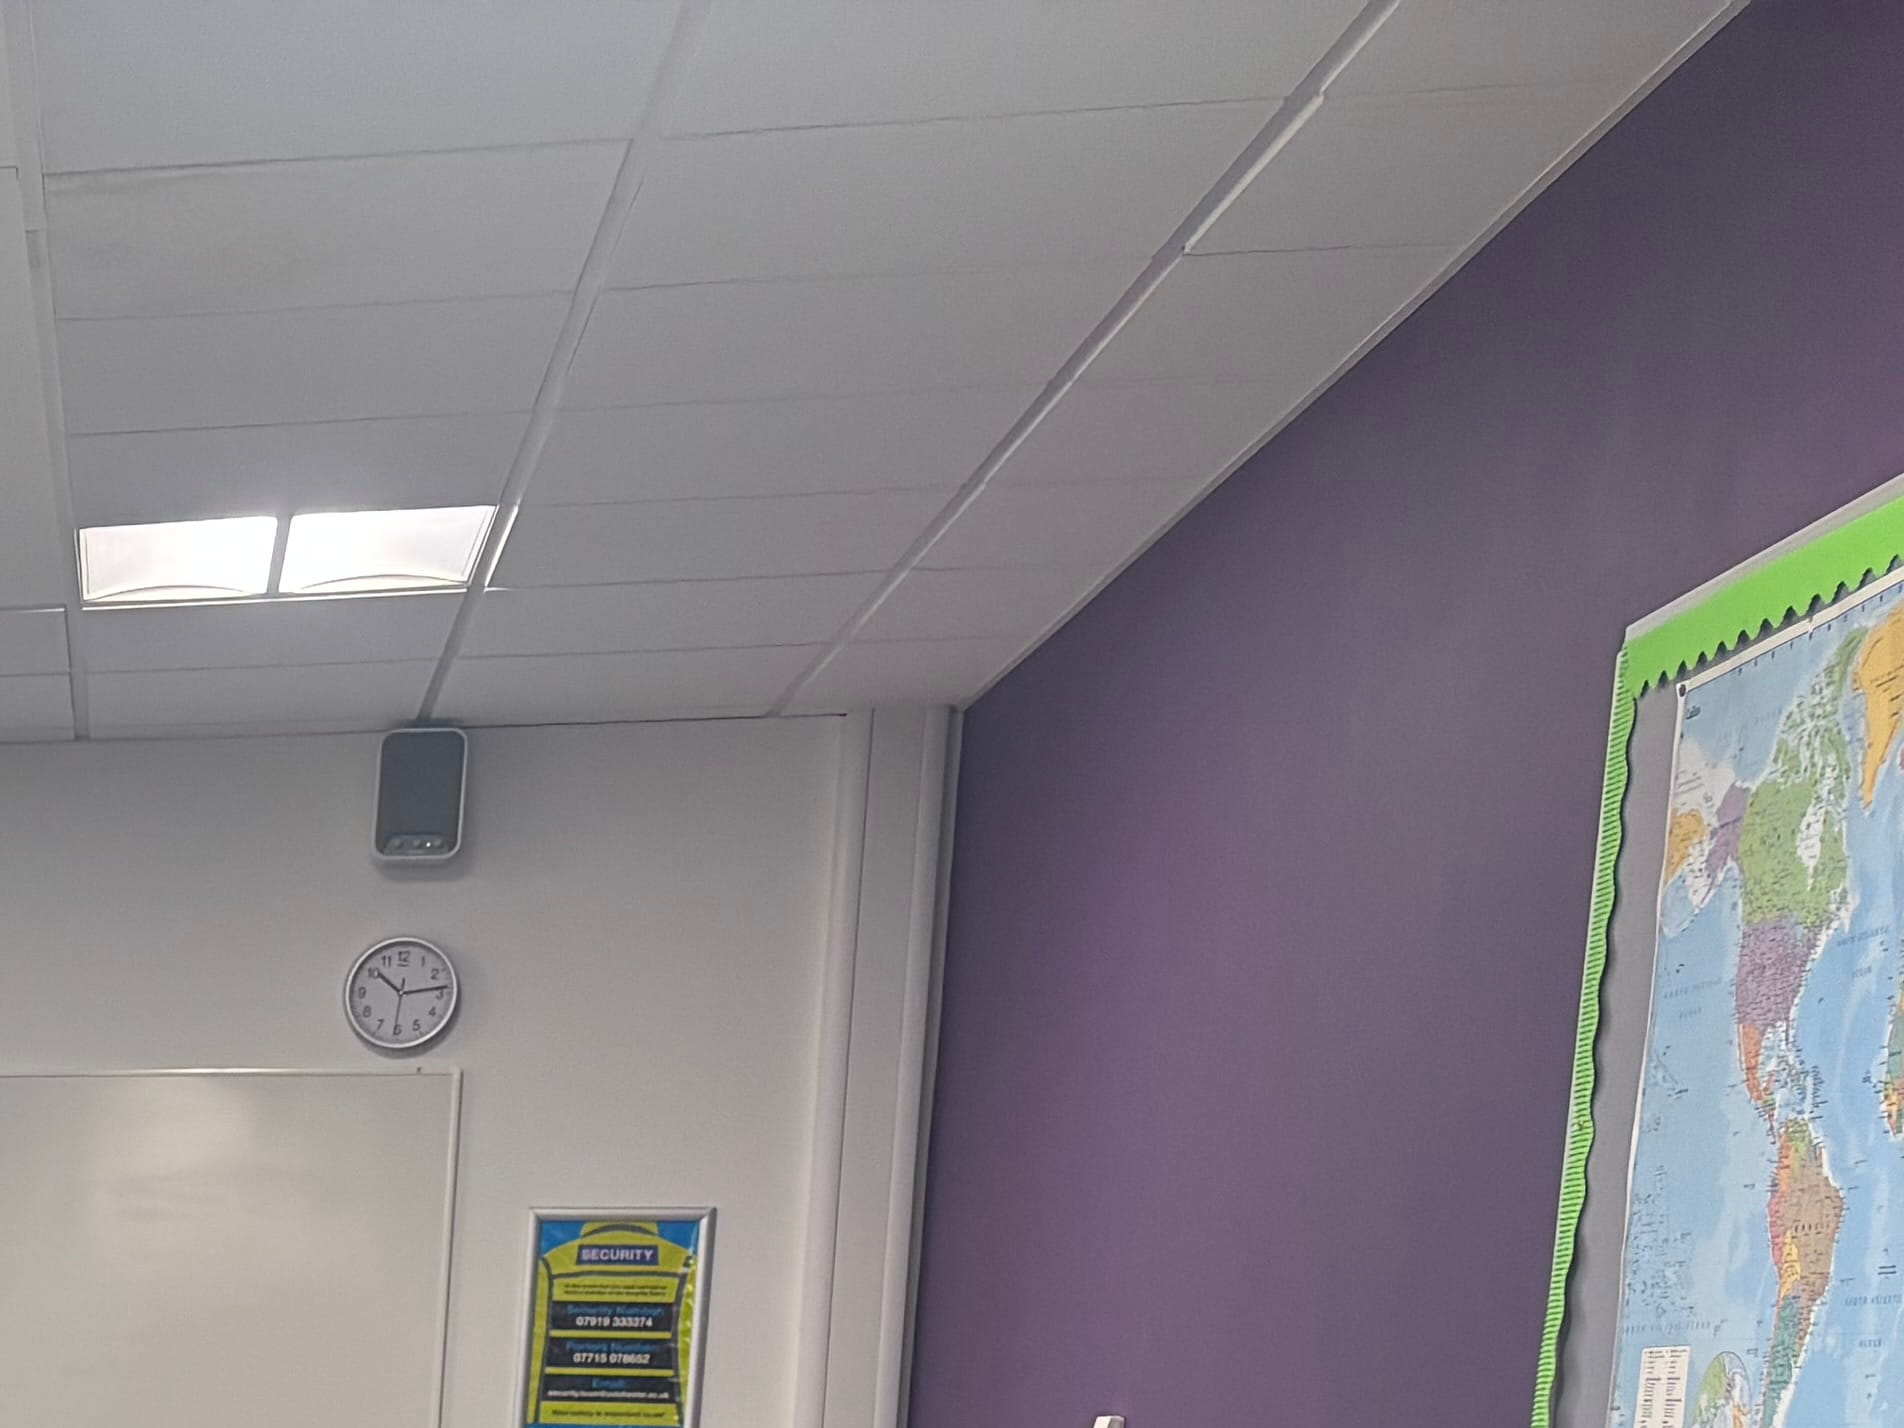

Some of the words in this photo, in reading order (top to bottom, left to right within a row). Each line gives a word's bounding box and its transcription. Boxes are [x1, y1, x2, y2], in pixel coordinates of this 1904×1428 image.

[382, 955, 392, 968] 11
[430, 968, 440, 980] 2
[358, 986, 367, 999] 9
[362, 1005, 371, 1018] 8
[428, 1006, 437, 1016] 4
[377, 1018, 385, 1031] 7
[412, 1019, 421, 1031] 5
[581, 1248, 654, 1261] SECURITY
